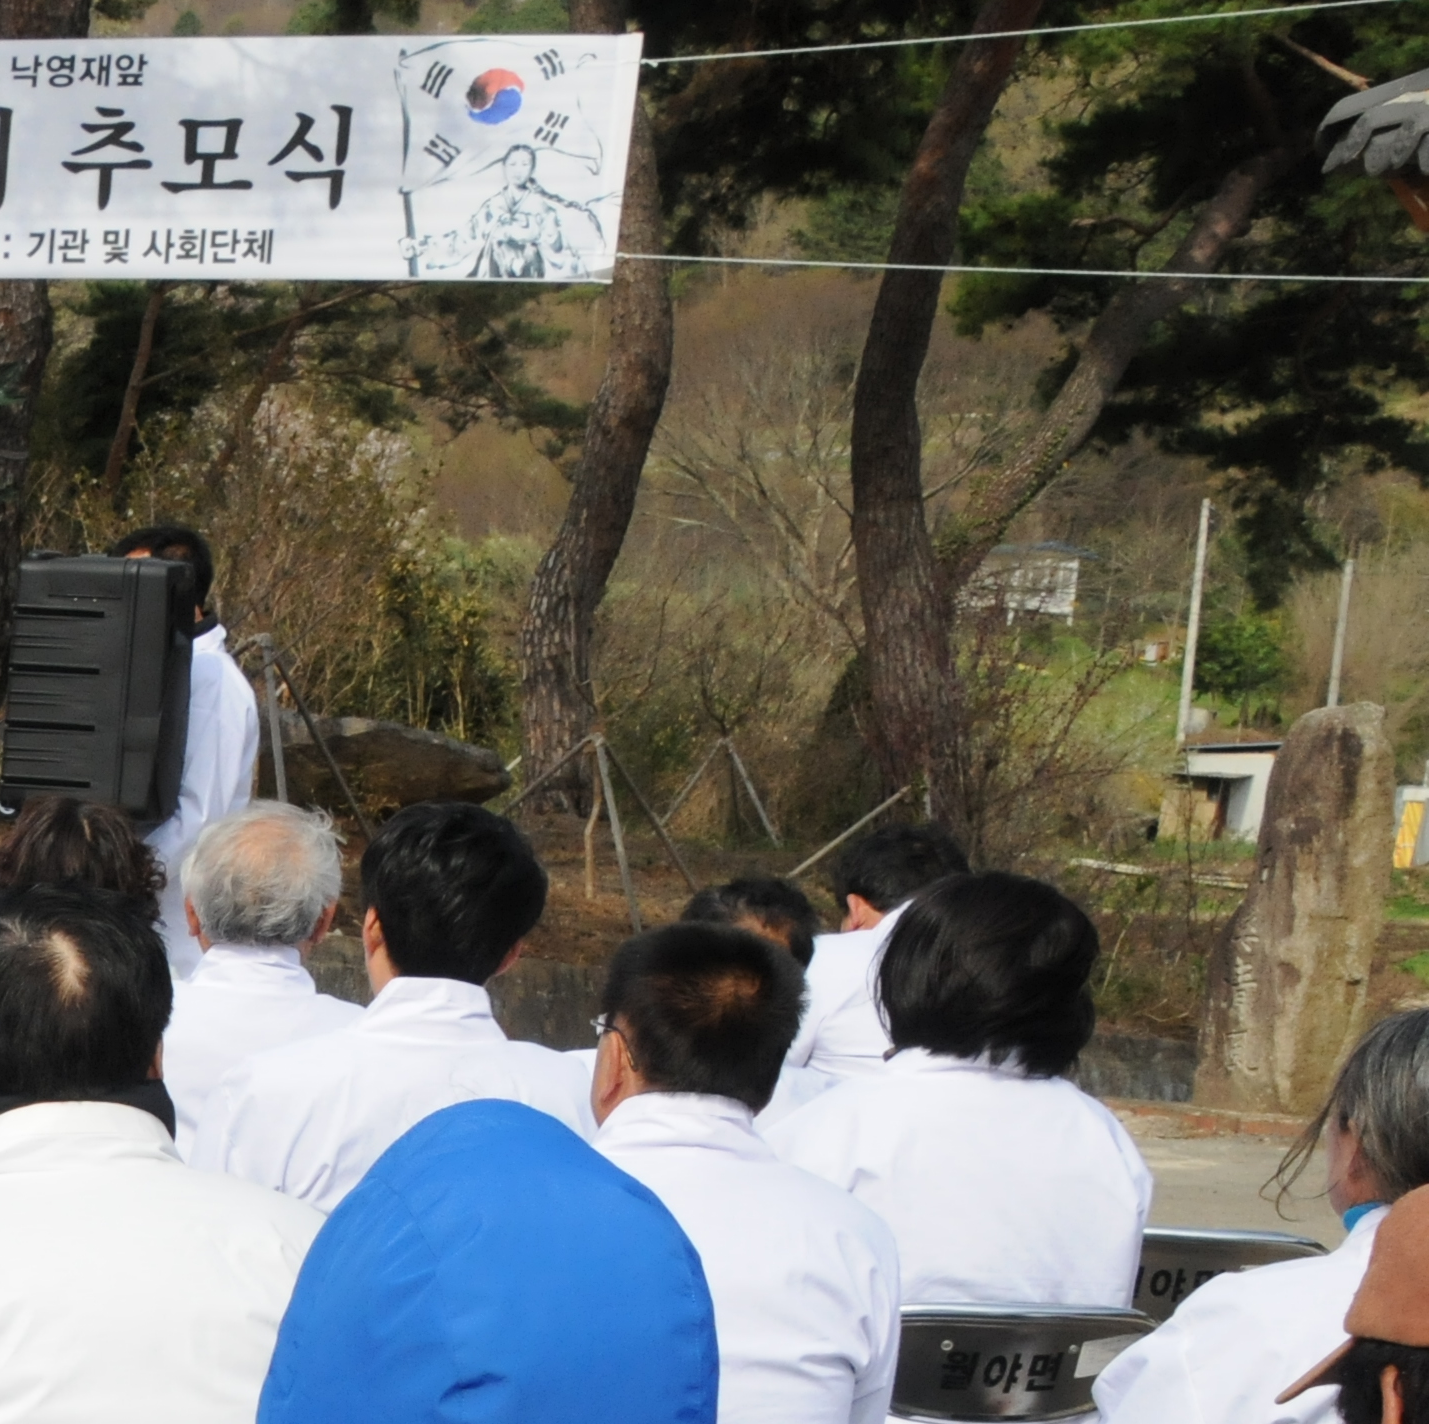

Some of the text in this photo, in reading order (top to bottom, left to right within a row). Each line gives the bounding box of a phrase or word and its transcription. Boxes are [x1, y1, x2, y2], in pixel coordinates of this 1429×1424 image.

[10, 53, 149, 89] 낙영재앞
[60, 103, 354, 211] 추모식
[26, 228, 90, 264] 기관
[102, 228, 131, 264] 및
[141, 228, 275, 264] 사회단체
[941, 1350, 1065, 1395] 월야면
